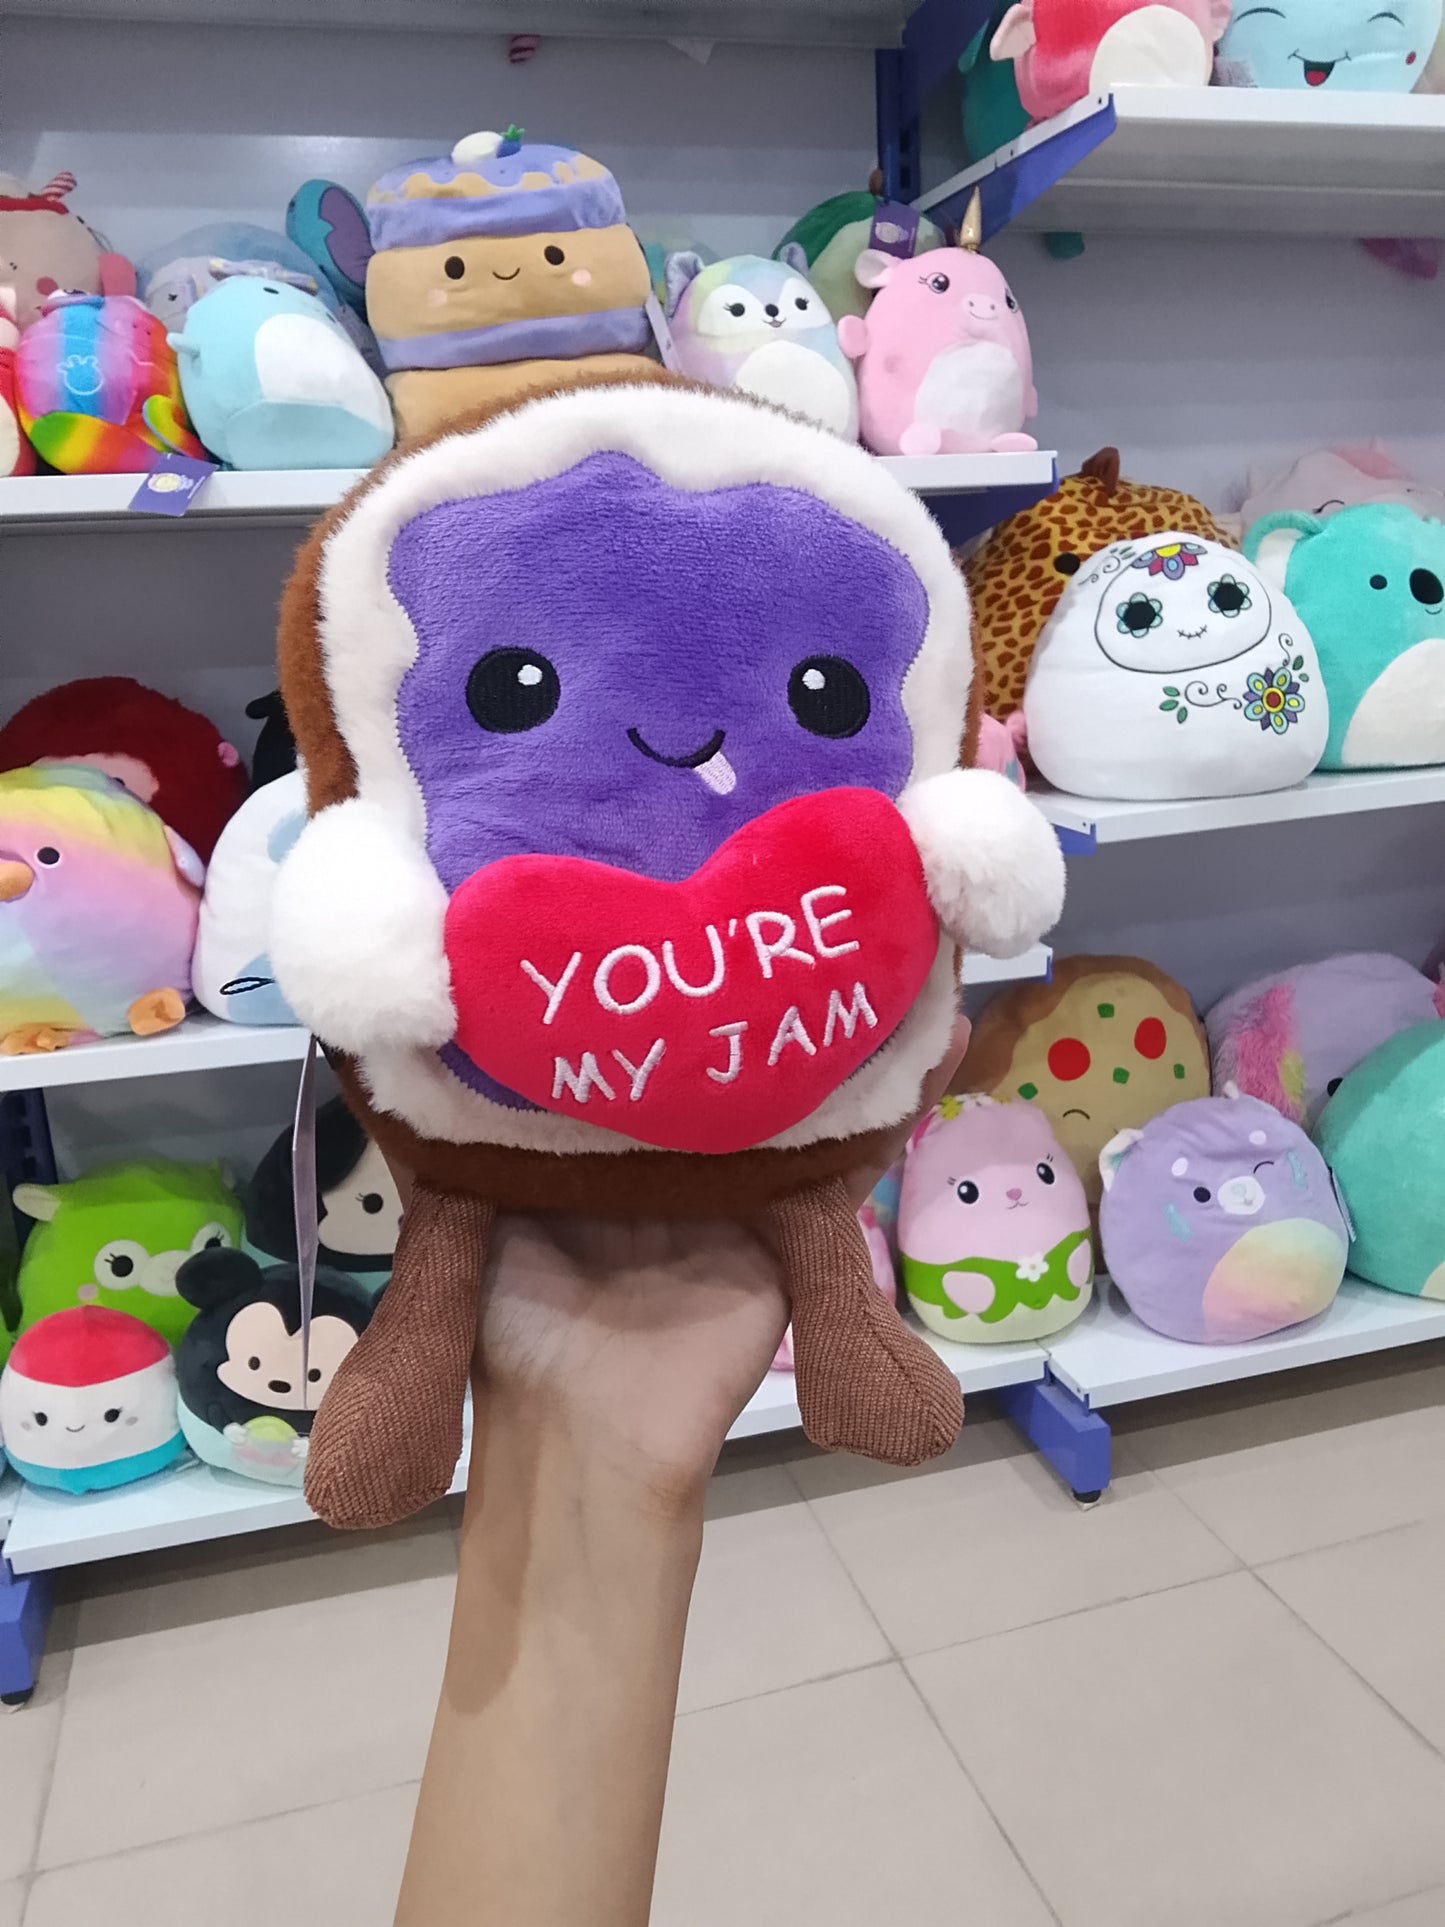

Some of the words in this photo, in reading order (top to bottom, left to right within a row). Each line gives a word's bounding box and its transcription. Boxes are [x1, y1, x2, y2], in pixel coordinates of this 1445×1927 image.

[520, 885, 860, 1024] YOU'RE
[552, 1038, 666, 1103] MY
[706, 981, 878, 1083] JAM
